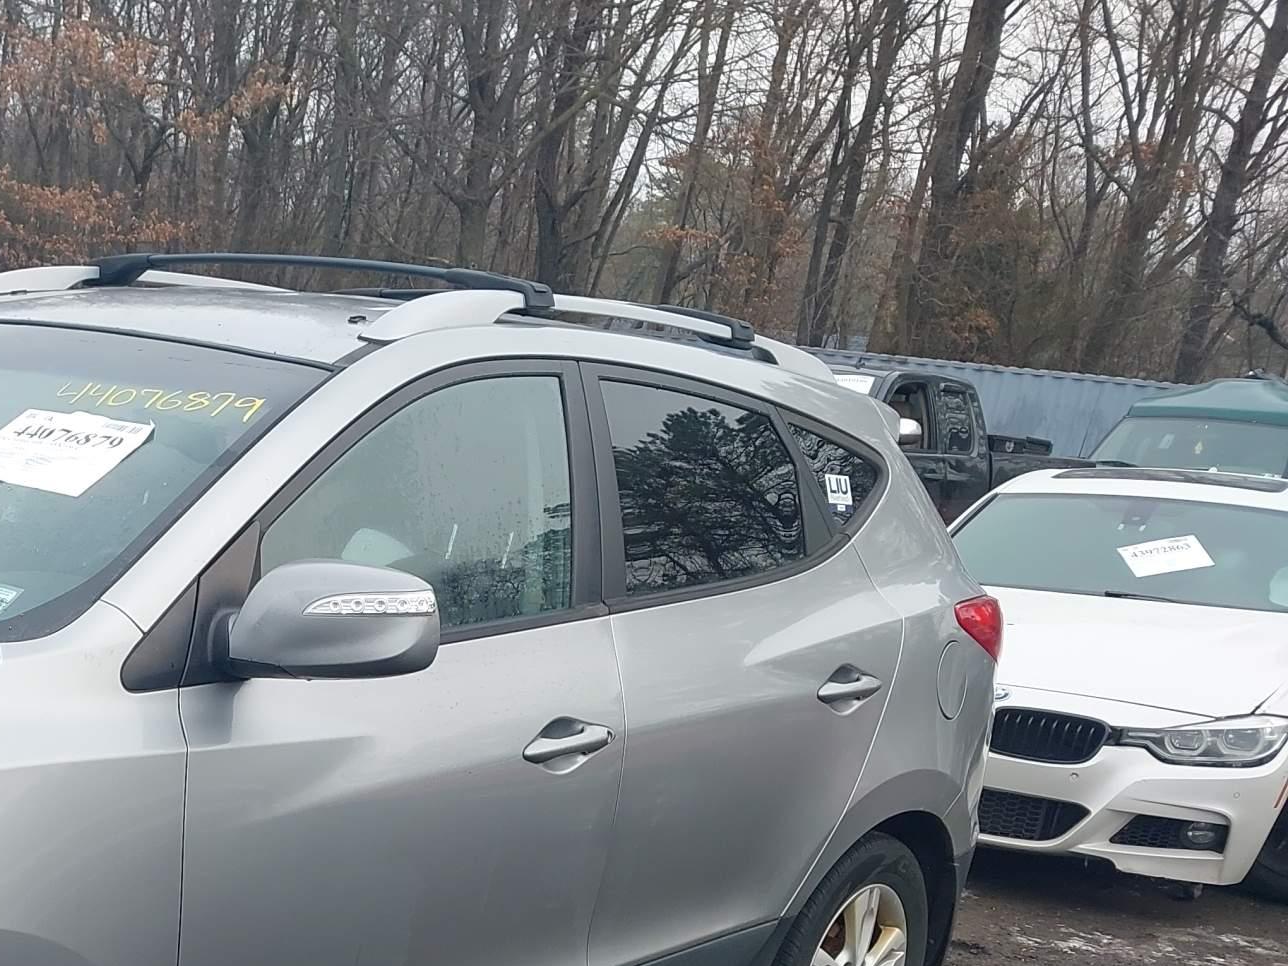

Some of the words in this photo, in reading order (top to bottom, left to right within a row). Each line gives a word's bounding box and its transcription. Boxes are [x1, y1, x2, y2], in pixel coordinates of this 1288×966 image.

[56, 382, 267, 423] 44076879
[13, 425, 124, 449] 44076879
[827, 476, 849, 495] LIU
